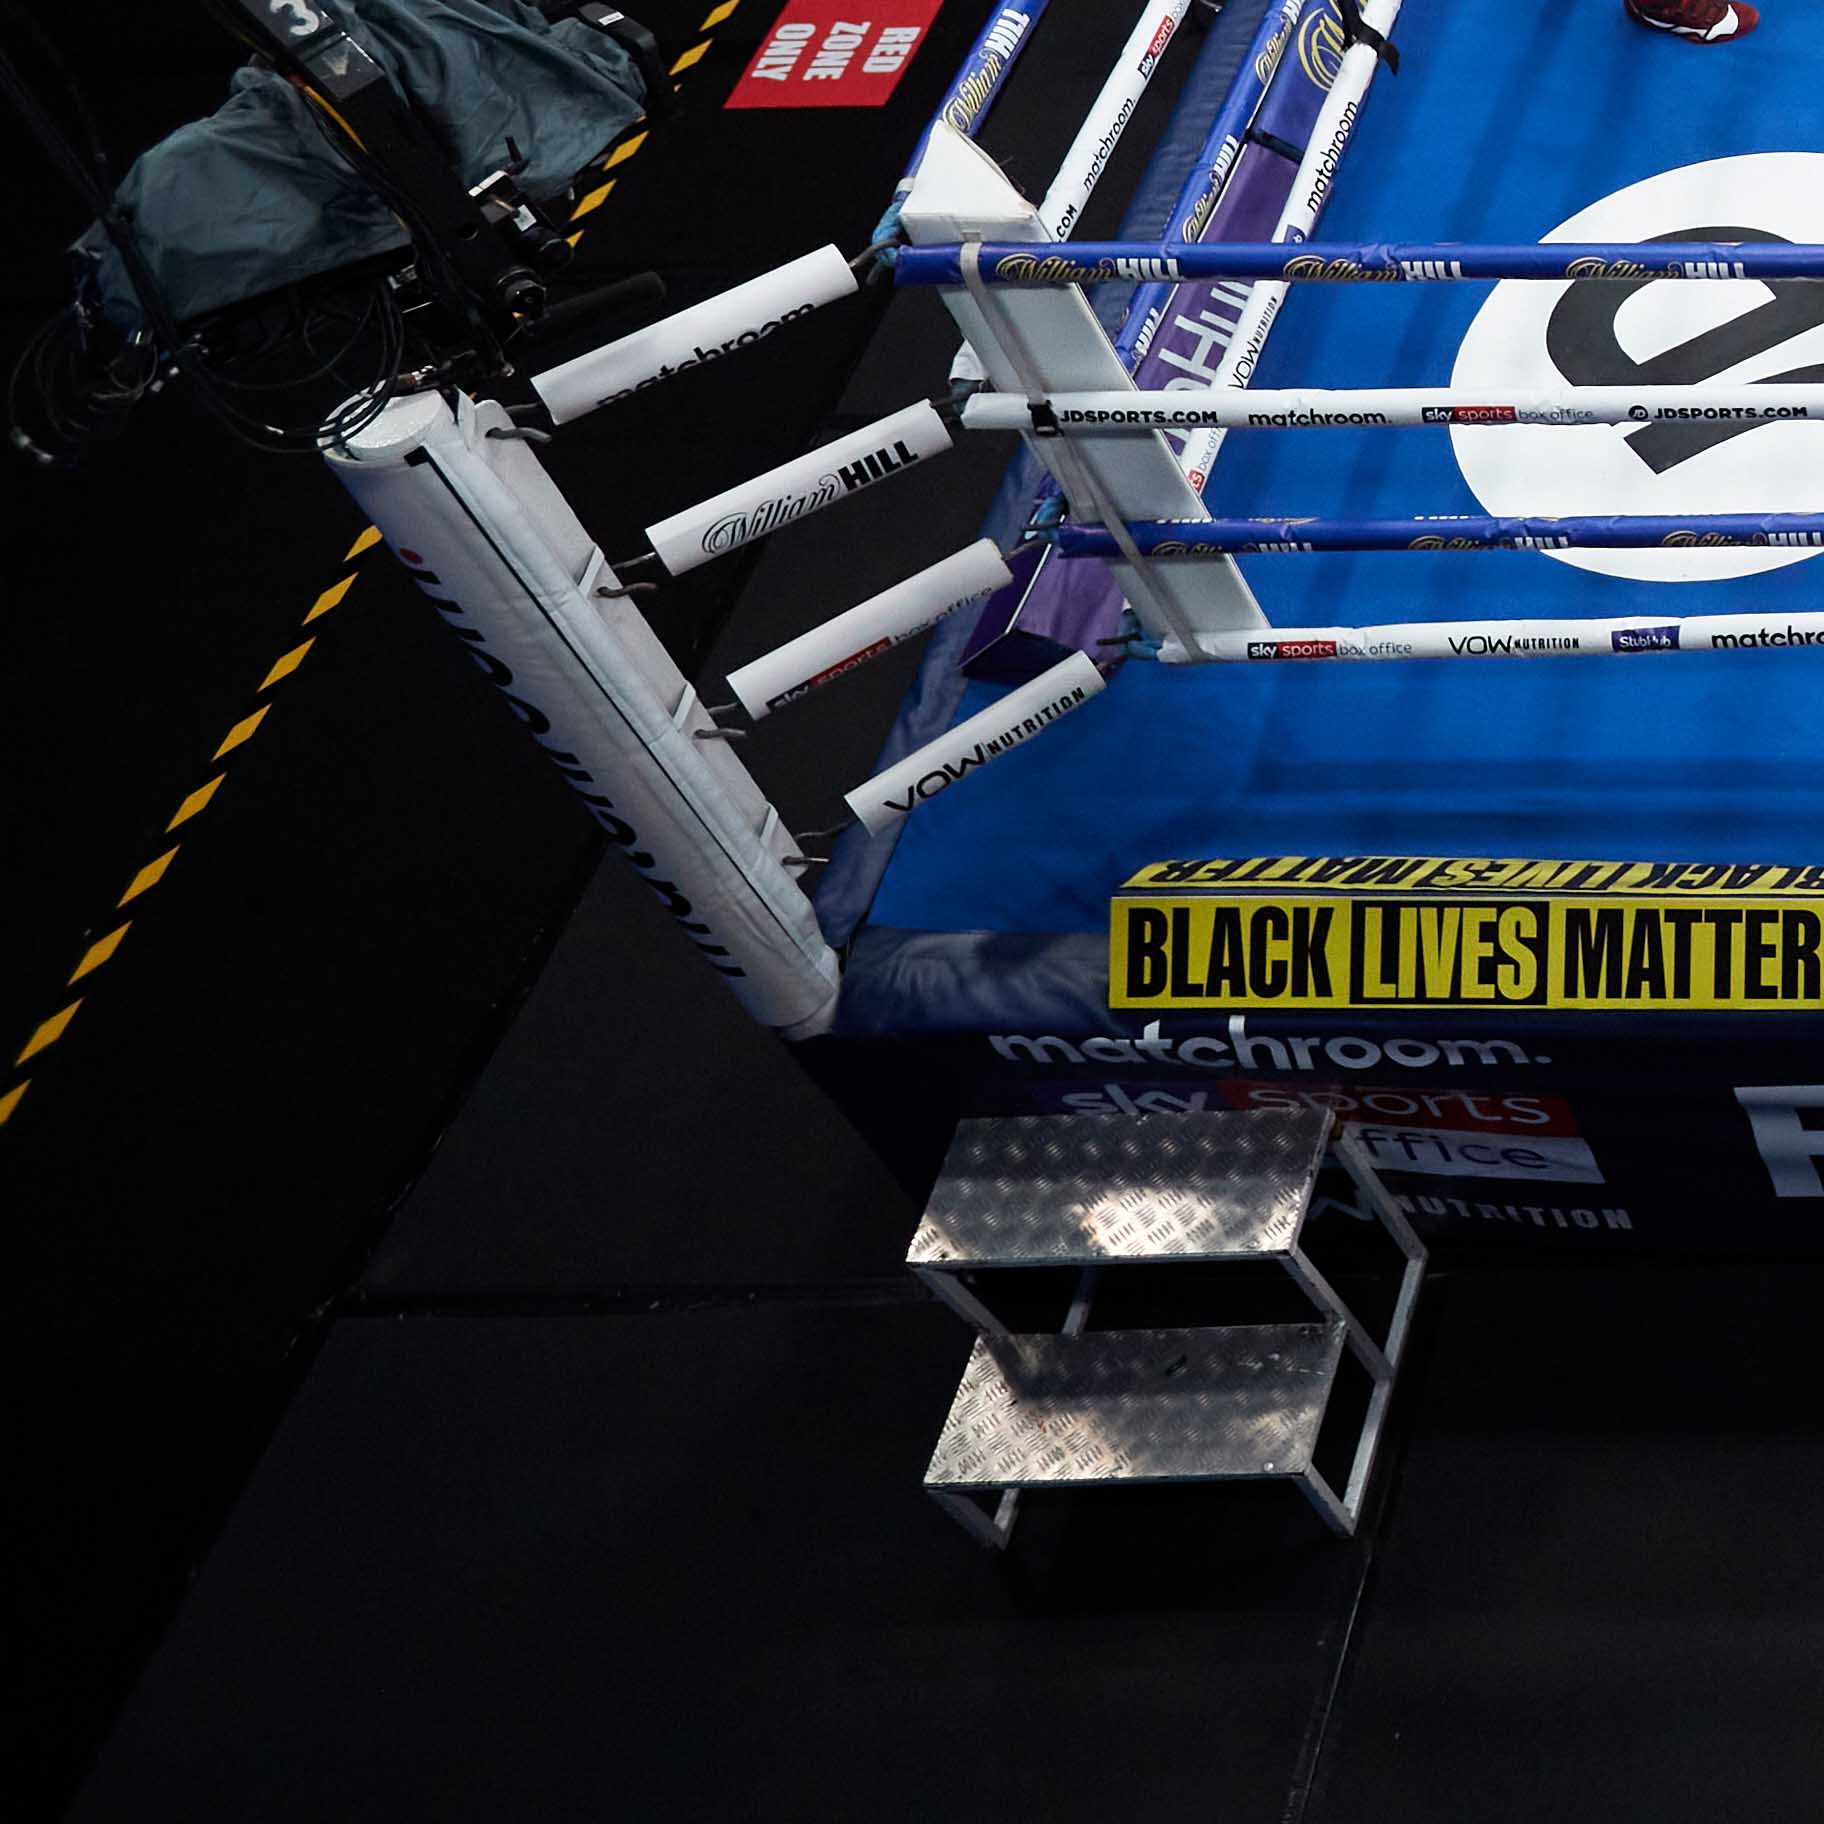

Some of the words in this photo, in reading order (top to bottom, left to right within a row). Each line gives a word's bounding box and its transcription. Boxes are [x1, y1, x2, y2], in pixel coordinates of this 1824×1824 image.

[751, 22, 817, 81] ONLY
[802, 21, 872, 81] ZONE
[862, 26, 922, 74] RED
[1083, 96, 1137, 190] matchroom.
[1115, 256, 1182, 280] HILL
[1059, 409, 1218, 425] JDSPORTS.COM
[1248, 407, 1394, 427] matchroom.
[1422, 406, 1453, 424] sky
[1454, 406, 1515, 423] sports
[1518, 405, 1547, 421] box
[1549, 405, 1595, 422] office
[701, 470, 841, 558] William
[837, 439, 920, 491] HILL
[1249, 642, 1277, 659] sky
[1278, 641, 1337, 659] sports
[1338, 640, 1368, 657] box
[1368, 640, 1413, 657] office
[1447, 635, 1515, 656] VOW
[1513, 636, 1581, 651] NUTRITION
[884, 743, 987, 813] VOW
[984, 686, 1087, 756] NUTRITION
[1125, 906, 1335, 1000] BLACK
[1361, 906, 1539, 1002] LIVES
[1562, 907, 1823, 1001] MATTER
[989, 1015, 1553, 1070] matchroom.
[1247, 1082, 1552, 1126] sports
